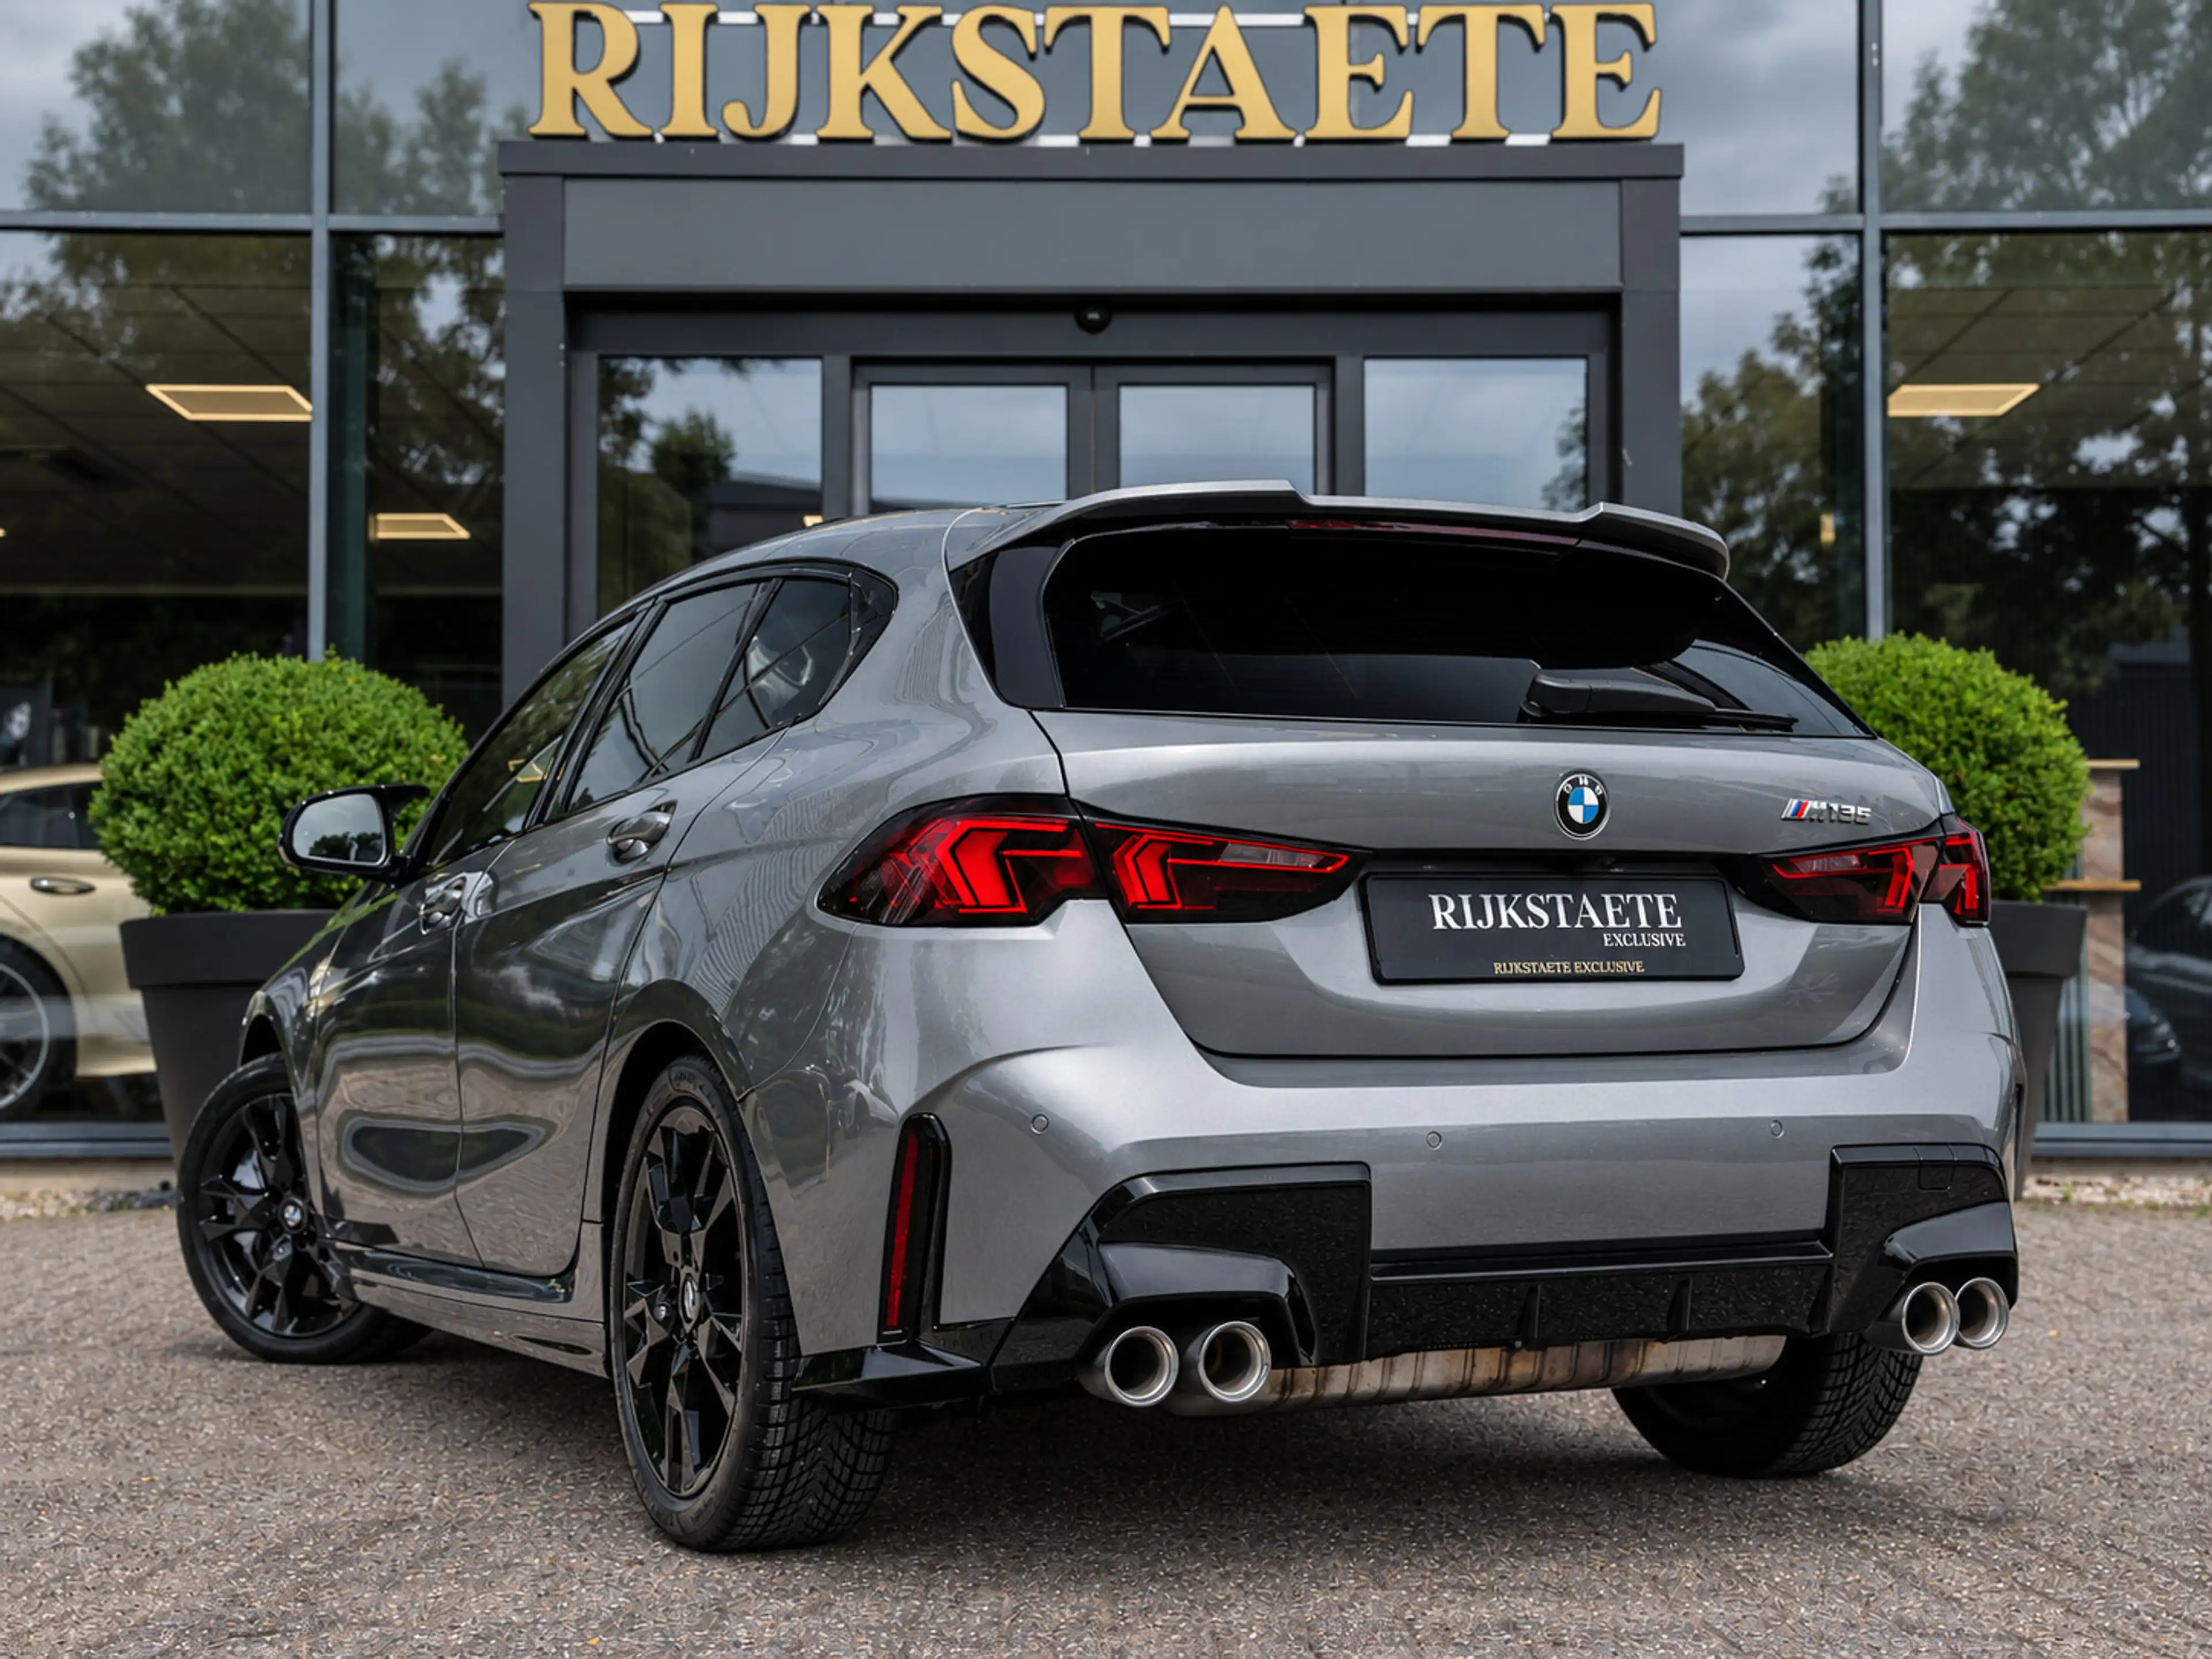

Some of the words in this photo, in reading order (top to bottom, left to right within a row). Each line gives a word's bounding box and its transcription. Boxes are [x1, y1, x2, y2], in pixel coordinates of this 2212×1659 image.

[530, 2, 1662, 141] RIJKSTAETE
[1428, 893, 1682, 930] RIJKSTAETE
[1603, 933, 1685, 946] EXCLUSIVE
[1493, 961, 1571, 975] RIJKSTAETE
[1574, 961, 1645, 974] EXCLUSIVE
